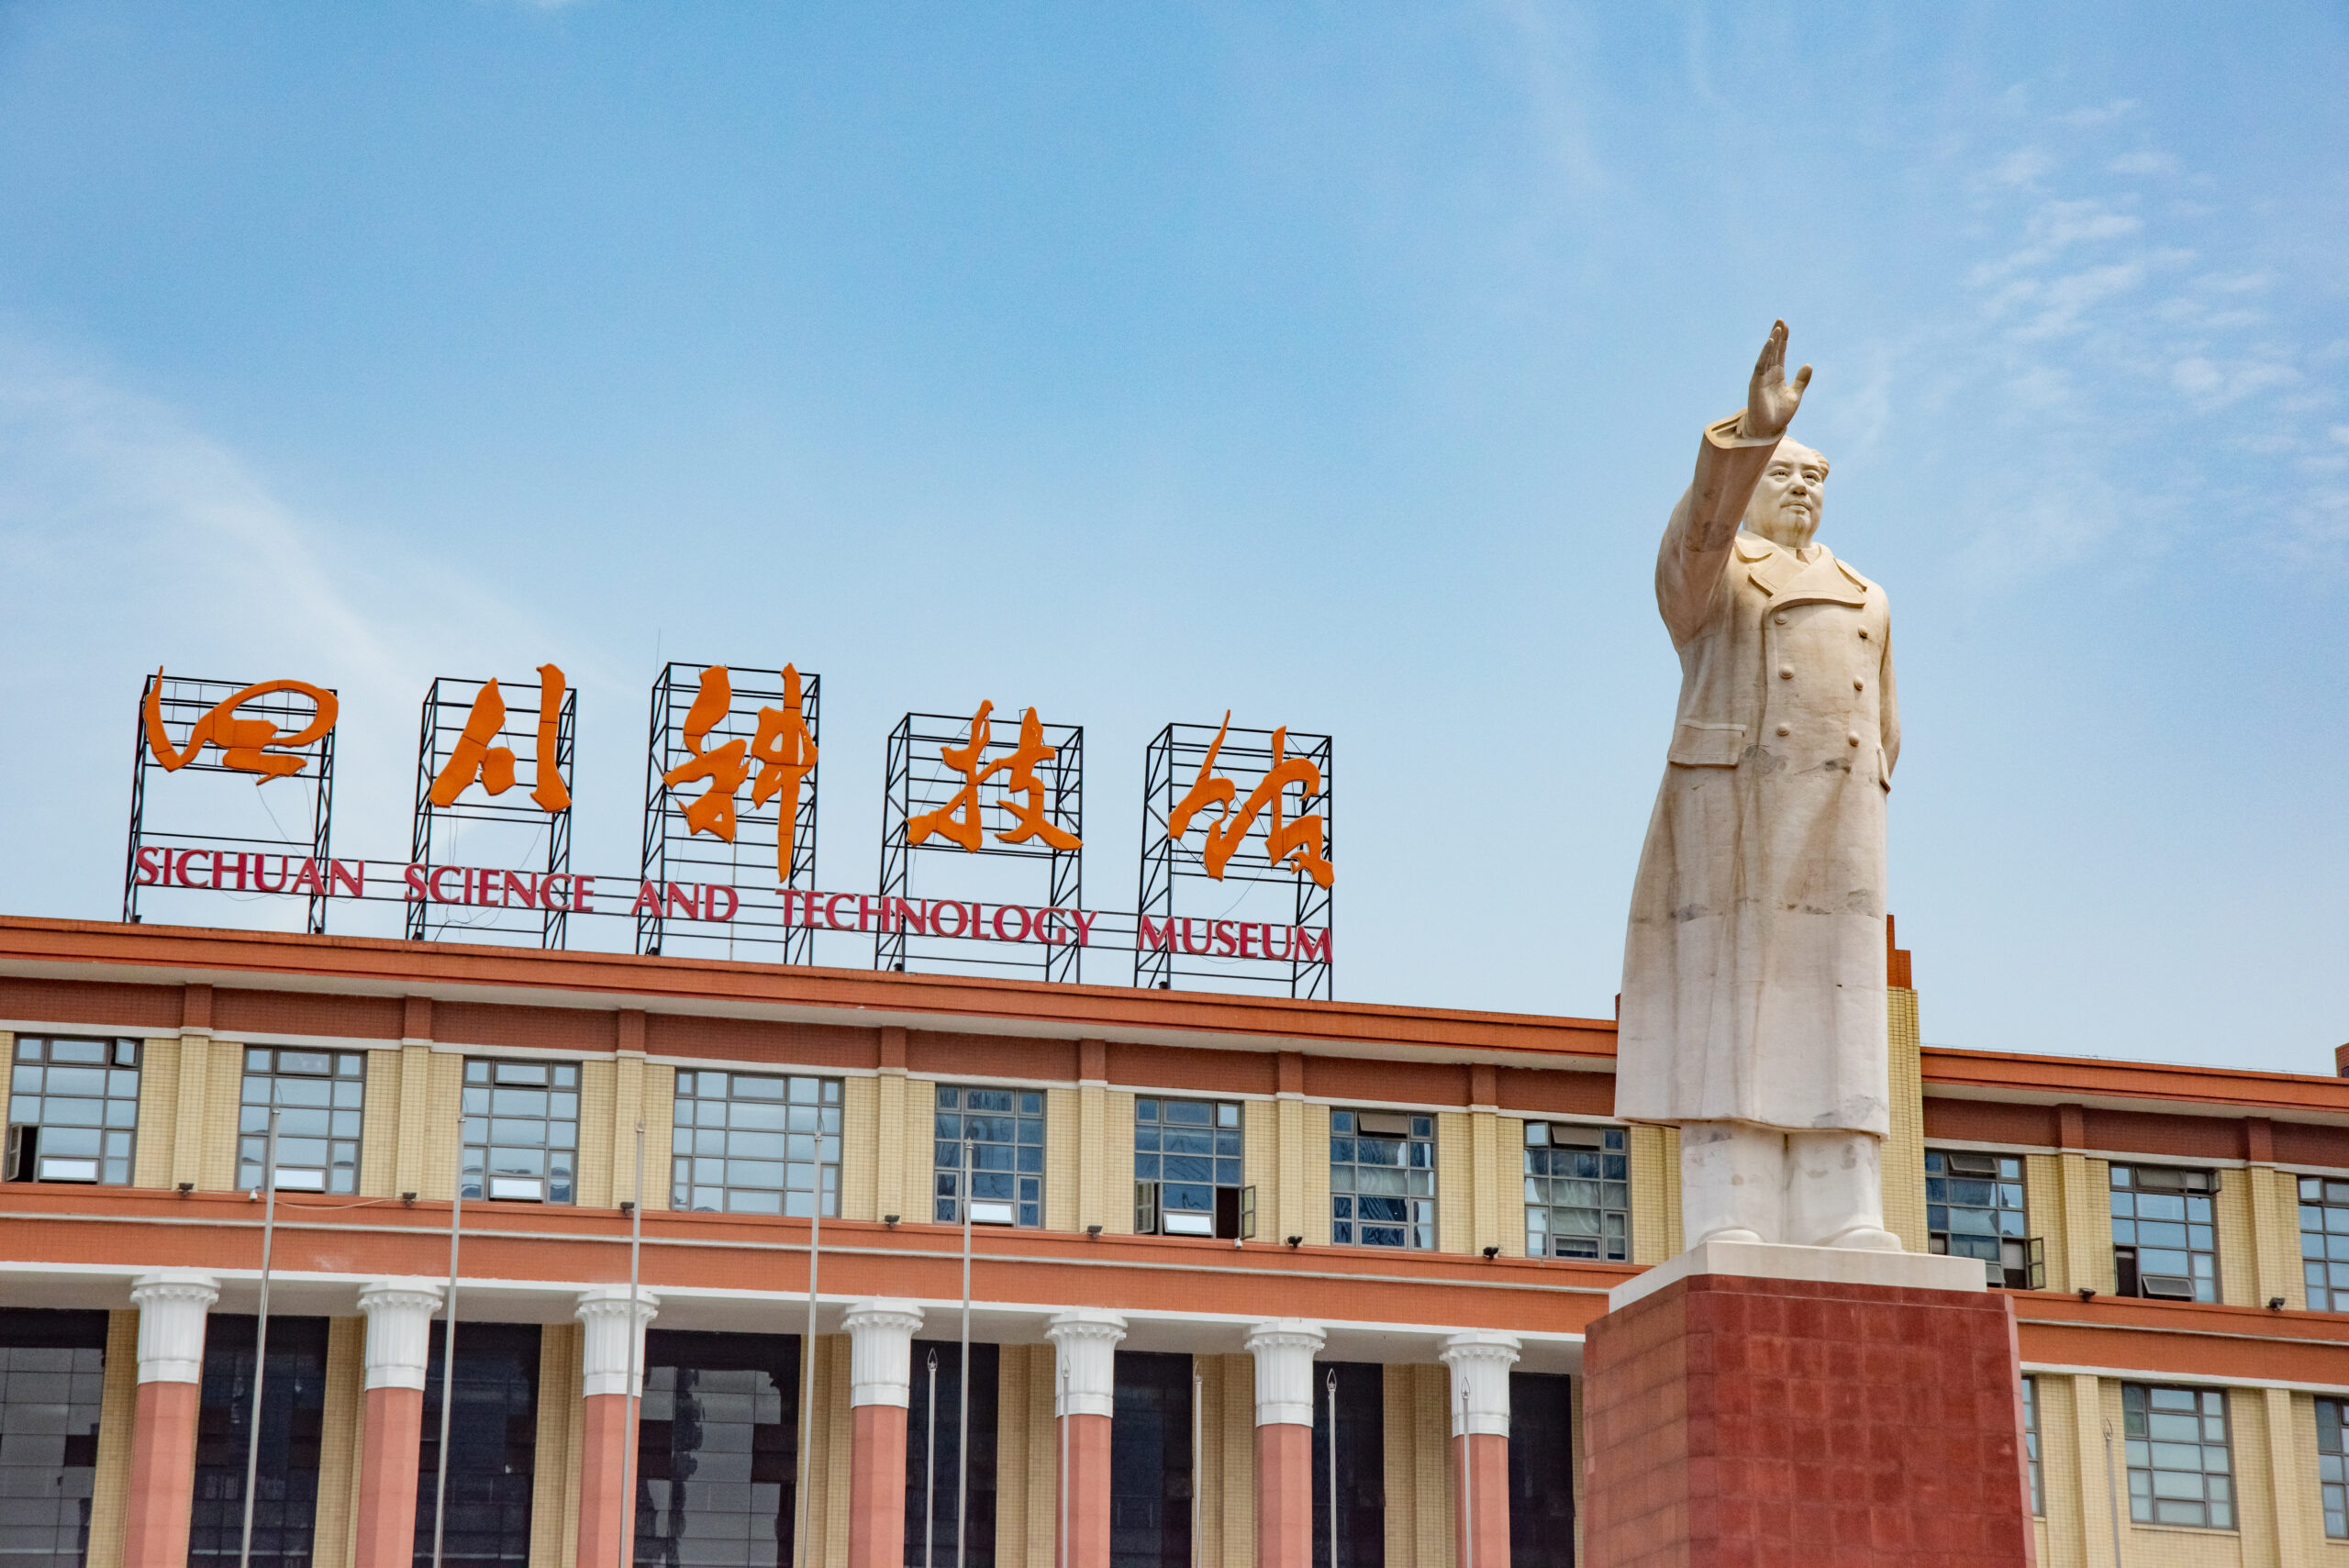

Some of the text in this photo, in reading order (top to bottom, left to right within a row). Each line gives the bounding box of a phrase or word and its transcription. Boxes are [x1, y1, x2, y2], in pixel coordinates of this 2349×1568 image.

[135, 846, 1333, 964] SICHUAN SCIENCE AND TECHNOLOGY MUSEUM
